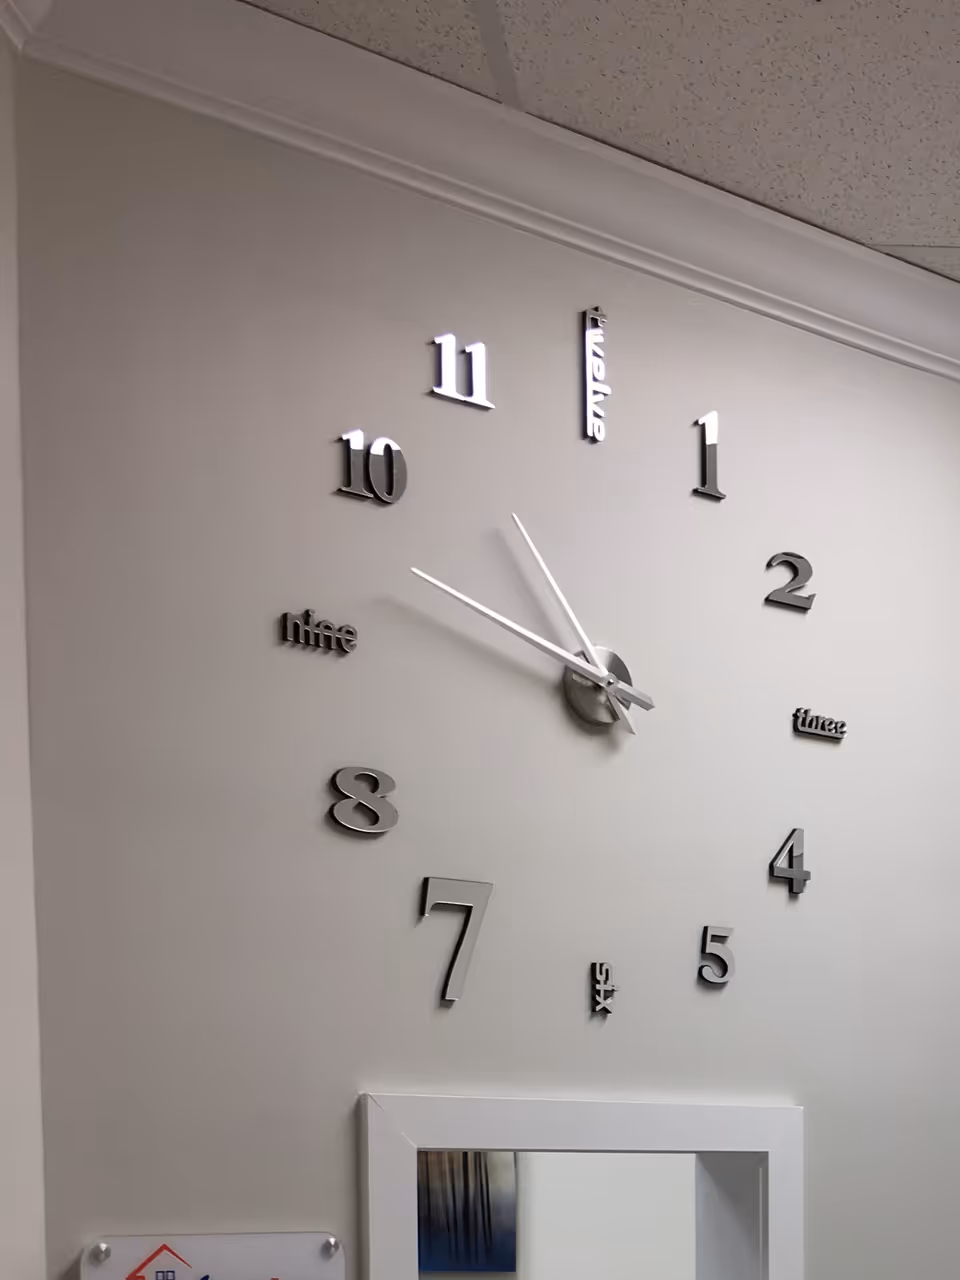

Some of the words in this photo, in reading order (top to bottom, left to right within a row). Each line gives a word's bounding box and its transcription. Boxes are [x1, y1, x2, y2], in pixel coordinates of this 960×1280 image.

[430, 332, 496, 412] 11
[336, 428, 408, 505] 10
[693, 410, 726, 500] 1
[764, 551, 816, 612] 2
[281, 608, 358, 654] nine
[792, 707, 847, 741] three
[329, 766, 399, 835] 8
[769, 828, 811, 895] 4
[418, 876, 494, 1006] 7
[699, 925, 736, 985] 5
[591, 961, 618, 1015] six
